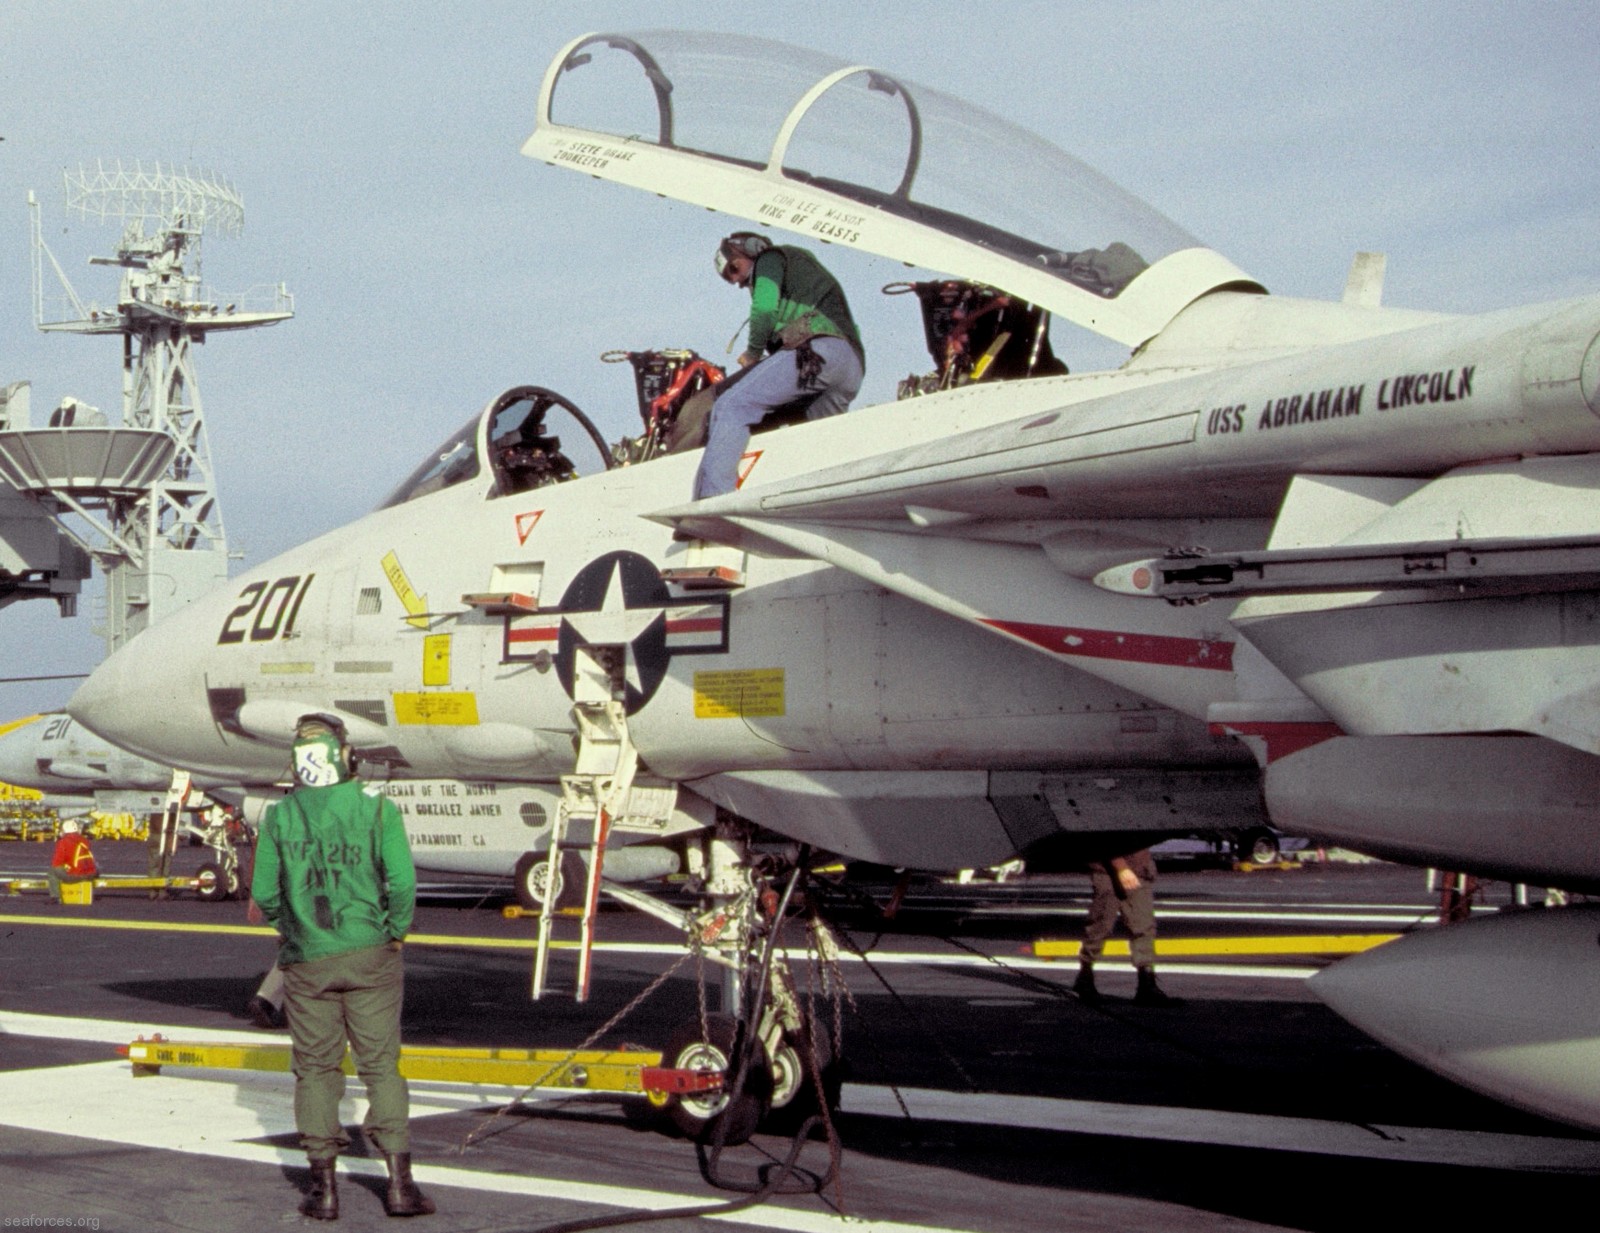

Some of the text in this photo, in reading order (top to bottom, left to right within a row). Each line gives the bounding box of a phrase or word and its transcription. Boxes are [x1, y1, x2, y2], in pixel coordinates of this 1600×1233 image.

[569, 142, 602, 155] STEVE
[797, 201, 820, 214] LEE
[790, 213, 808, 226] OF
[812, 220, 860, 243] BEASTS
[1207, 365, 1477, 435] USS ABRAHAM LINCOLN
[216, 573, 316, 646] 201
[42, 718, 72, 741] 211
[421, 784, 432, 797] OF
[440, 784, 458, 797] THE
[416, 803, 462, 816] GONZALEZ
[469, 803, 502, 817] JAVIER
[472, 834, 486, 846] CA
